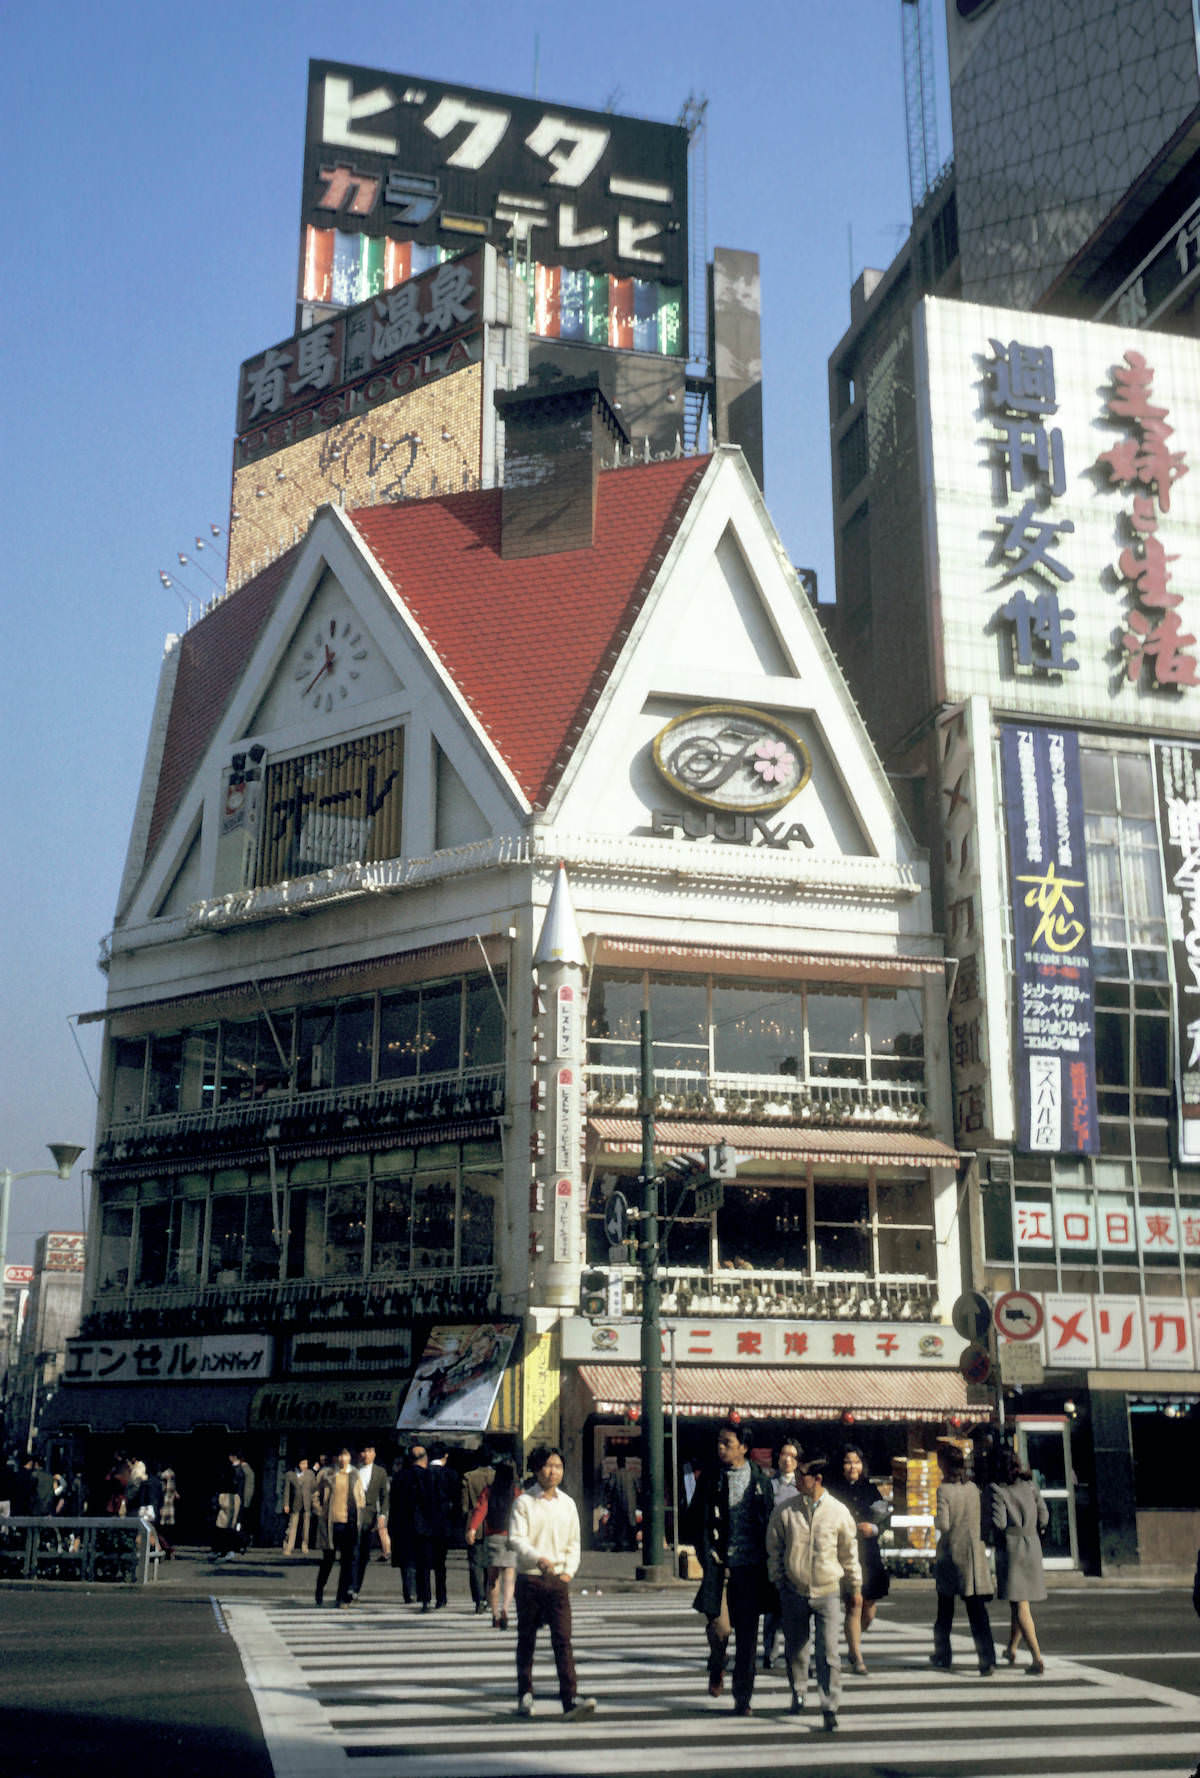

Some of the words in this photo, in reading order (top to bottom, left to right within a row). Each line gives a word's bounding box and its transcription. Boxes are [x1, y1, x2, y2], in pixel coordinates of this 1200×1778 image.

[322, 71, 674, 203] ビクター
[243, 324, 337, 420] 有馬
[371, 263, 477, 361] 温泉
[984, 338, 1080, 671] 週刊女性
[1096, 350, 1200, 687] 主婦と生活
[651, 807, 815, 850] FUJIYA
[1015, 861, 1086, 953] 恋
[65, 1343, 198, 1378] エンゼル
[660, 1329, 901, 1357] 二家洋菓子
[1004, 1308, 1200, 1354] メリカ
[258, 1391, 338, 1421] Nikon
